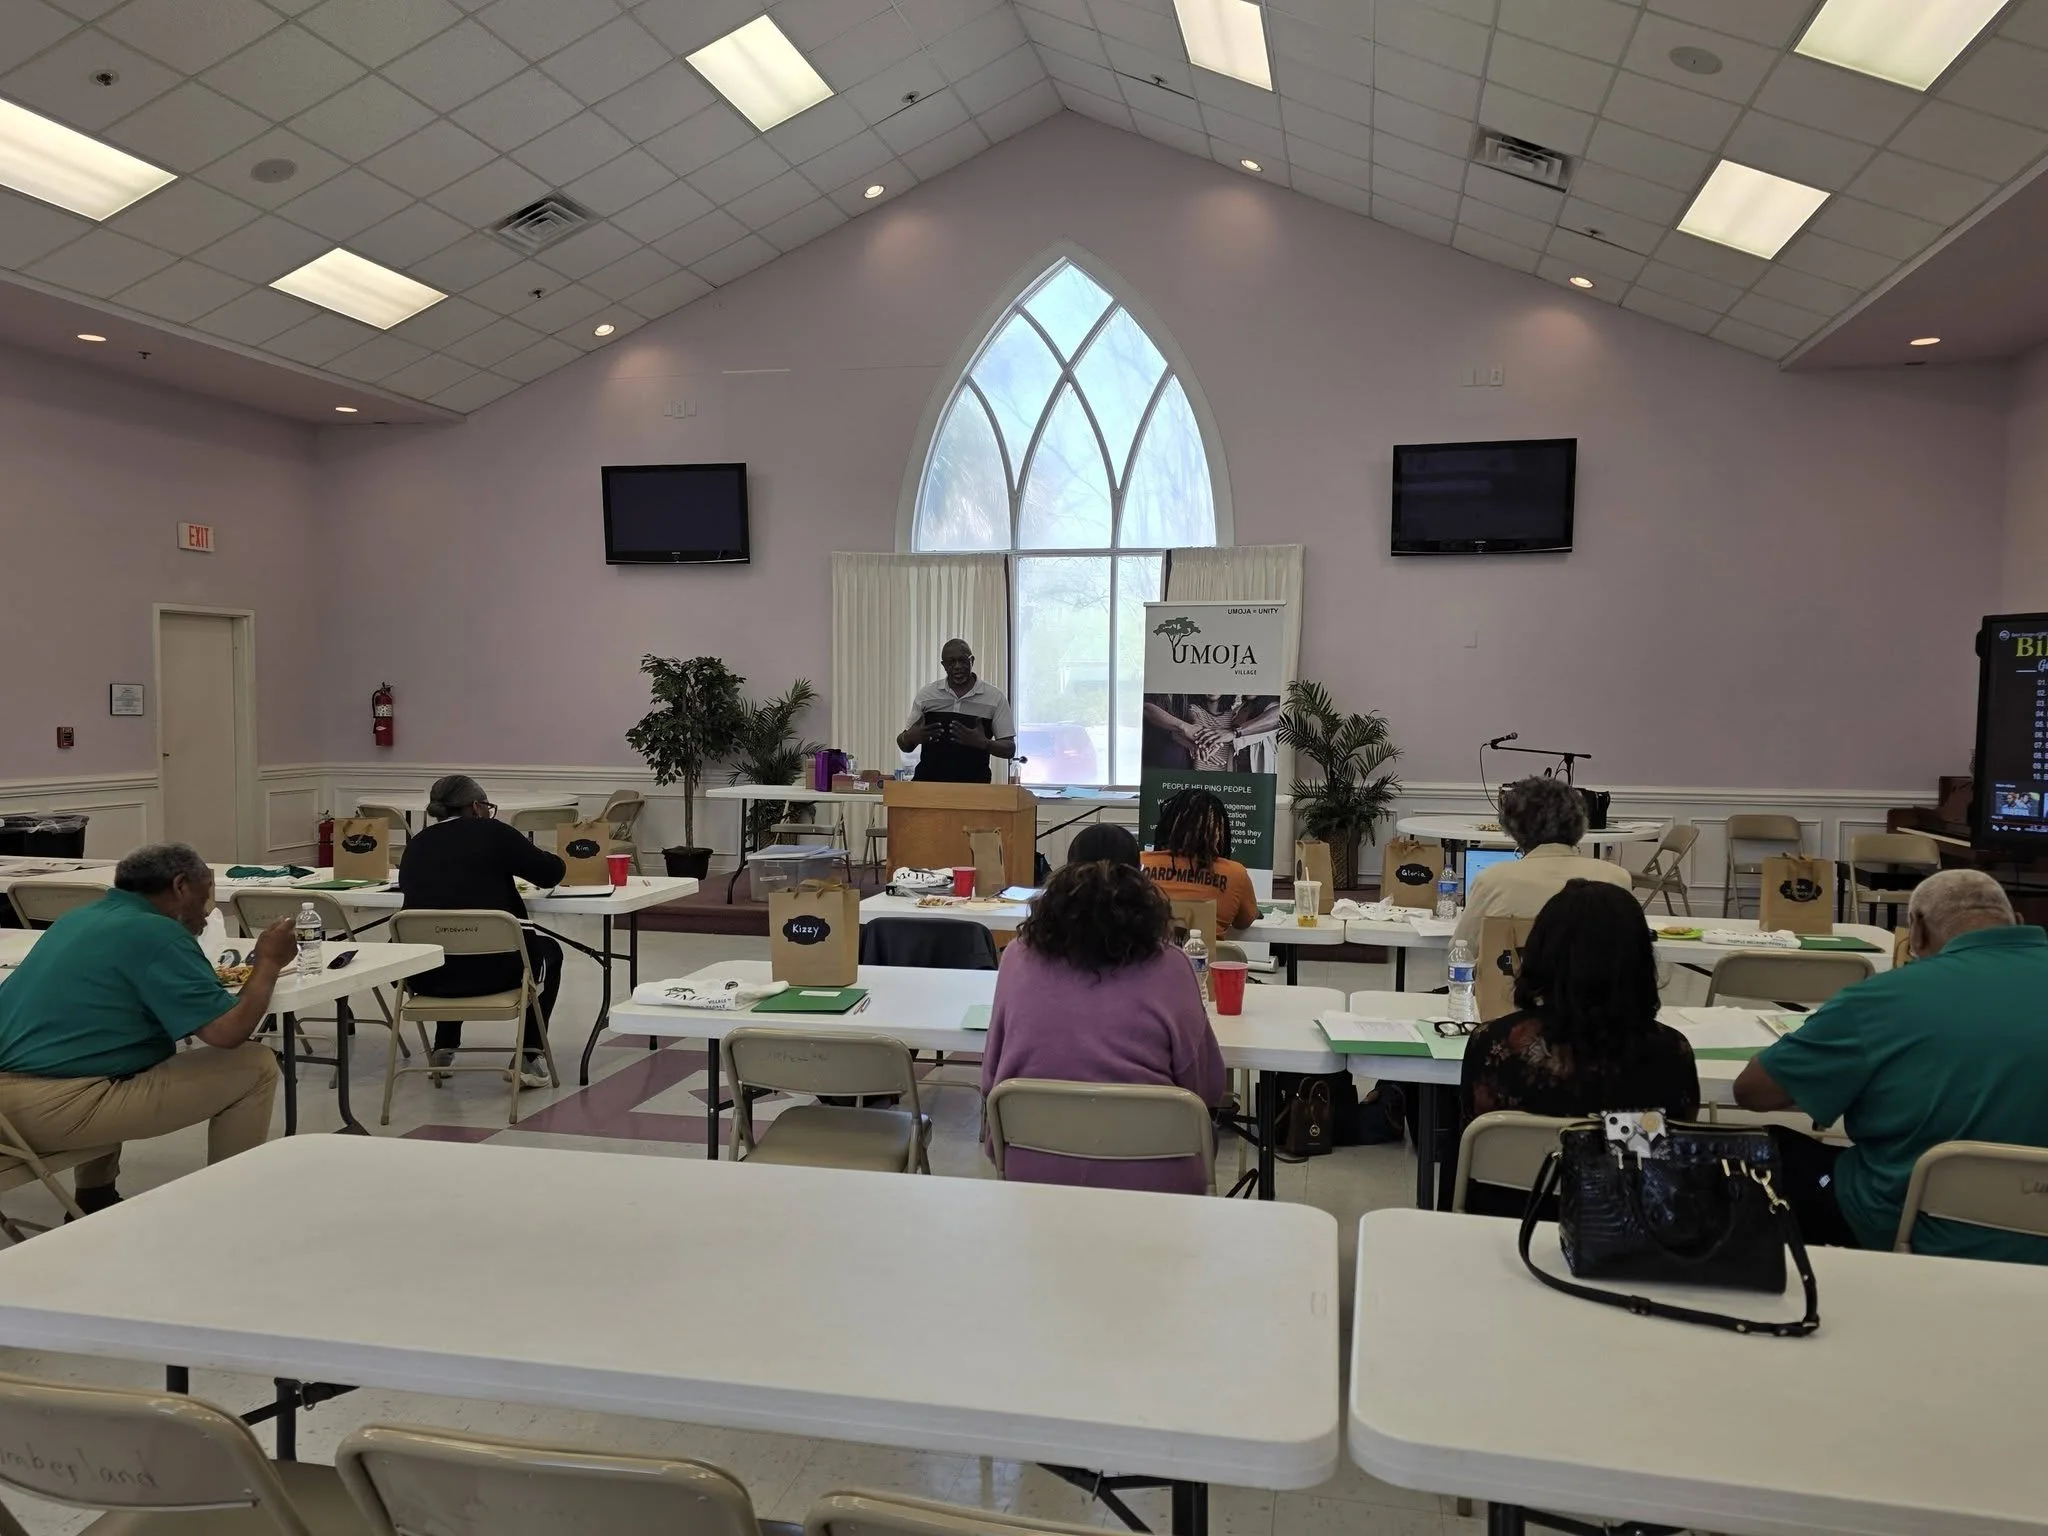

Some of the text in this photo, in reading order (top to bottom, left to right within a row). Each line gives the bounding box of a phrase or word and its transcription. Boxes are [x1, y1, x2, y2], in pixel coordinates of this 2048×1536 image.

[189, 525, 209, 549] EXIT
[1227, 607, 1252, 615] UMOJA
[1258, 607, 1279, 615] UNITY
[1172, 644, 1258, 669] UMOJA
[1162, 782, 1190, 791] PEOPLE
[1223, 785, 1252, 794] PEOPLE
[1224, 803, 1257, 812] nagement
[1227, 811, 1247, 819] zation
[1247, 829, 1262, 838] they
[575, 844, 590, 852] Kim
[1143, 866, 1228, 890] OARD MEMBER
[1401, 869, 1426, 878] Gloria
[792, 923, 820, 938] Kizzy
[0, 1442, 157, 1488] mberland
